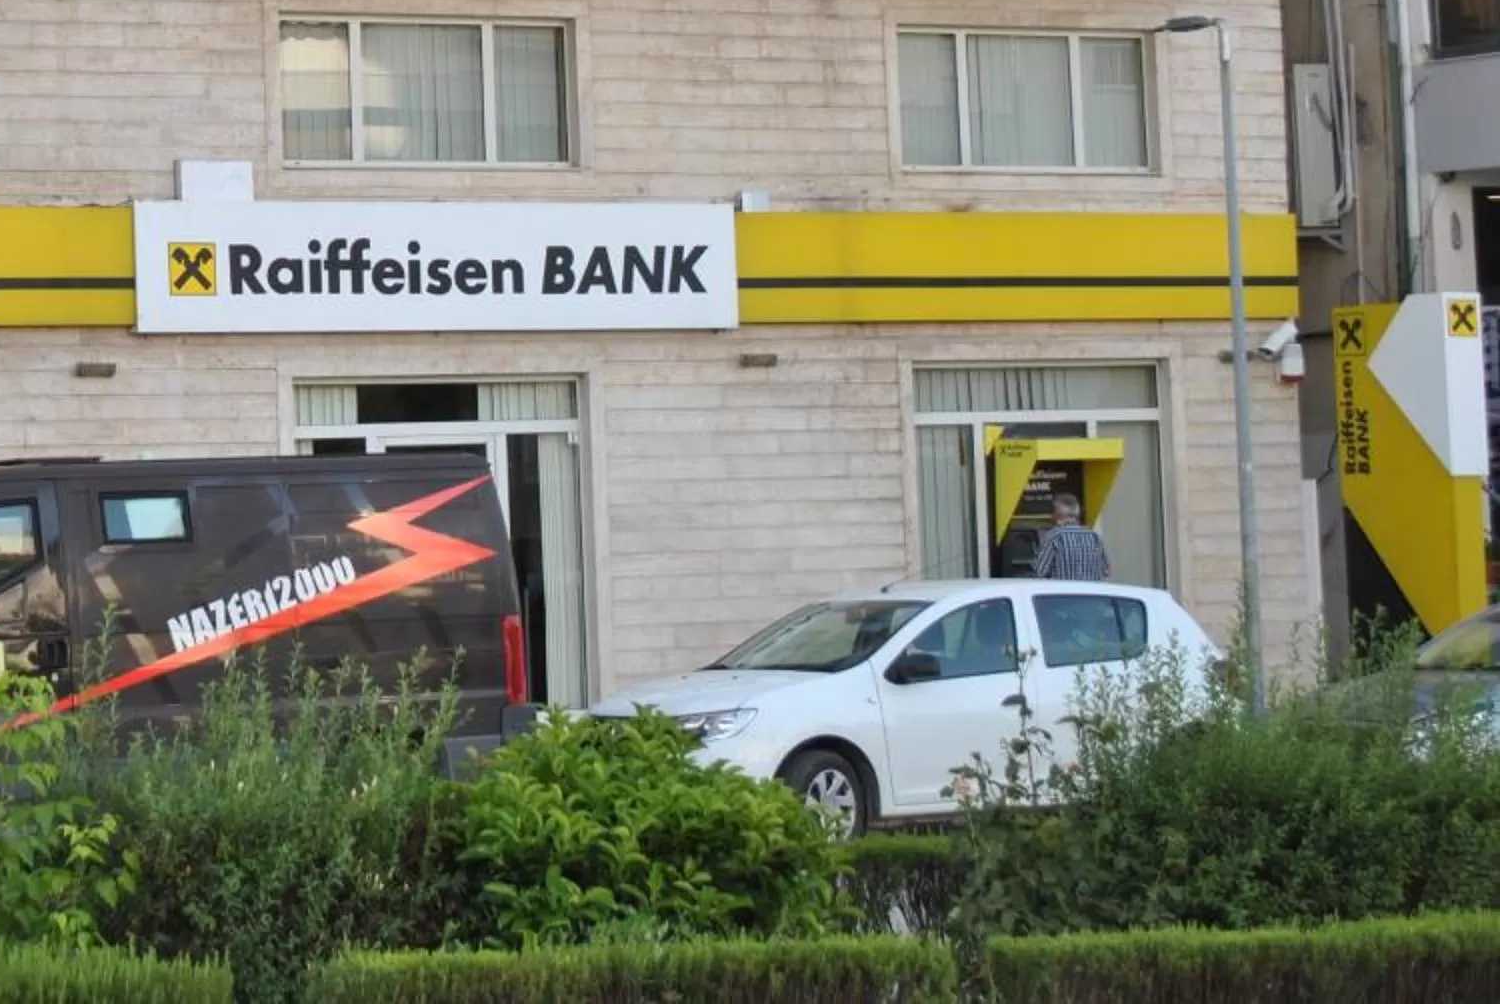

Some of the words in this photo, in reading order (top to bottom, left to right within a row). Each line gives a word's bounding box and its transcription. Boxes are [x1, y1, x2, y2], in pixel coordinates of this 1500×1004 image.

[228, 237, 525, 295] Raiffeisen
[541, 244, 709, 295] BANK
[1340, 359, 1357, 475] Raiffeisen
[1356, 407, 1371, 475] BANK
